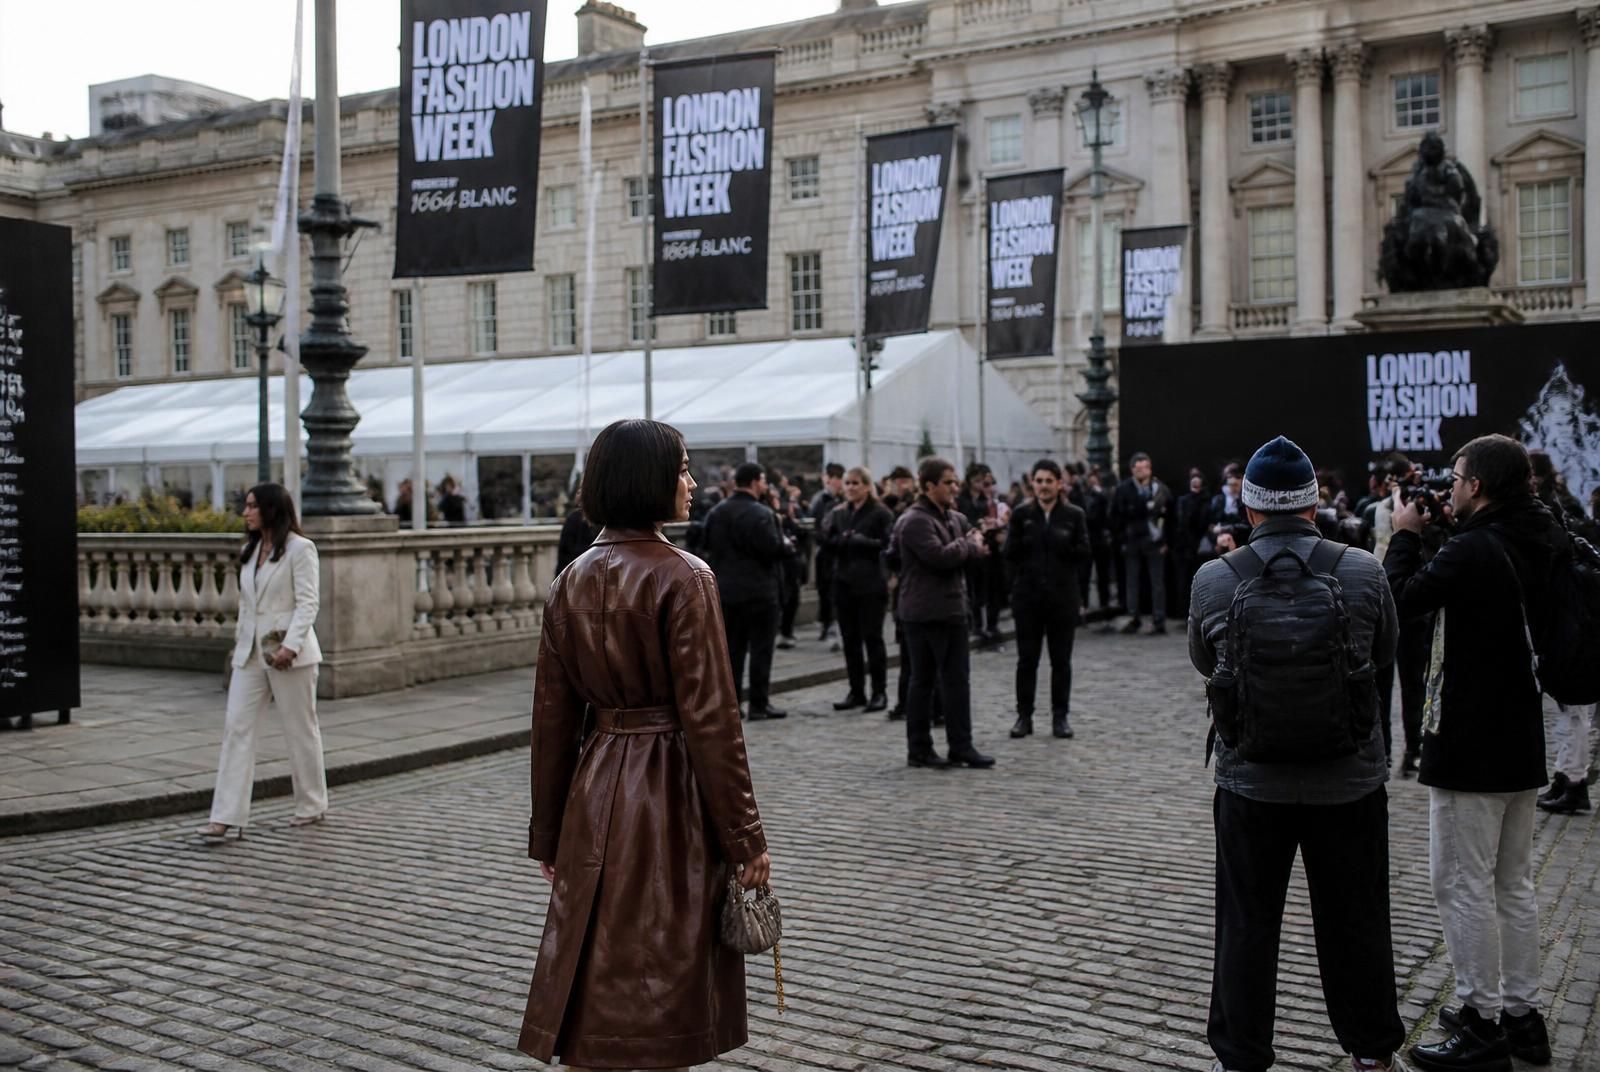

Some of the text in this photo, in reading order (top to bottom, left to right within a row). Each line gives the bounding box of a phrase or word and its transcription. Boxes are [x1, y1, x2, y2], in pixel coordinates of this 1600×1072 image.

[413, 11, 531, 68] LONDON
[411, 59, 535, 115] FASHION
[662, 87, 761, 137] LONDON
[411, 110, 496, 163] WEEK
[662, 128, 765, 177] FASHION
[872, 154, 942, 195] LONDON
[411, 186, 517, 214] 1664 BLANC
[662, 173, 732, 219] WEEK
[871, 186, 943, 228] FASHION
[991, 195, 1053, 230] LONDON
[701, 236, 752, 257] BLANC
[871, 222, 918, 262] WEEK
[991, 224, 1055, 259] FASHION
[1125, 245, 1182, 273] LONDON
[991, 256, 1034, 289] WEEK
[1366, 350, 1471, 386] LONDON
[1367, 383, 1478, 418] FASHION
[1368, 417, 1442, 451] WEEK
